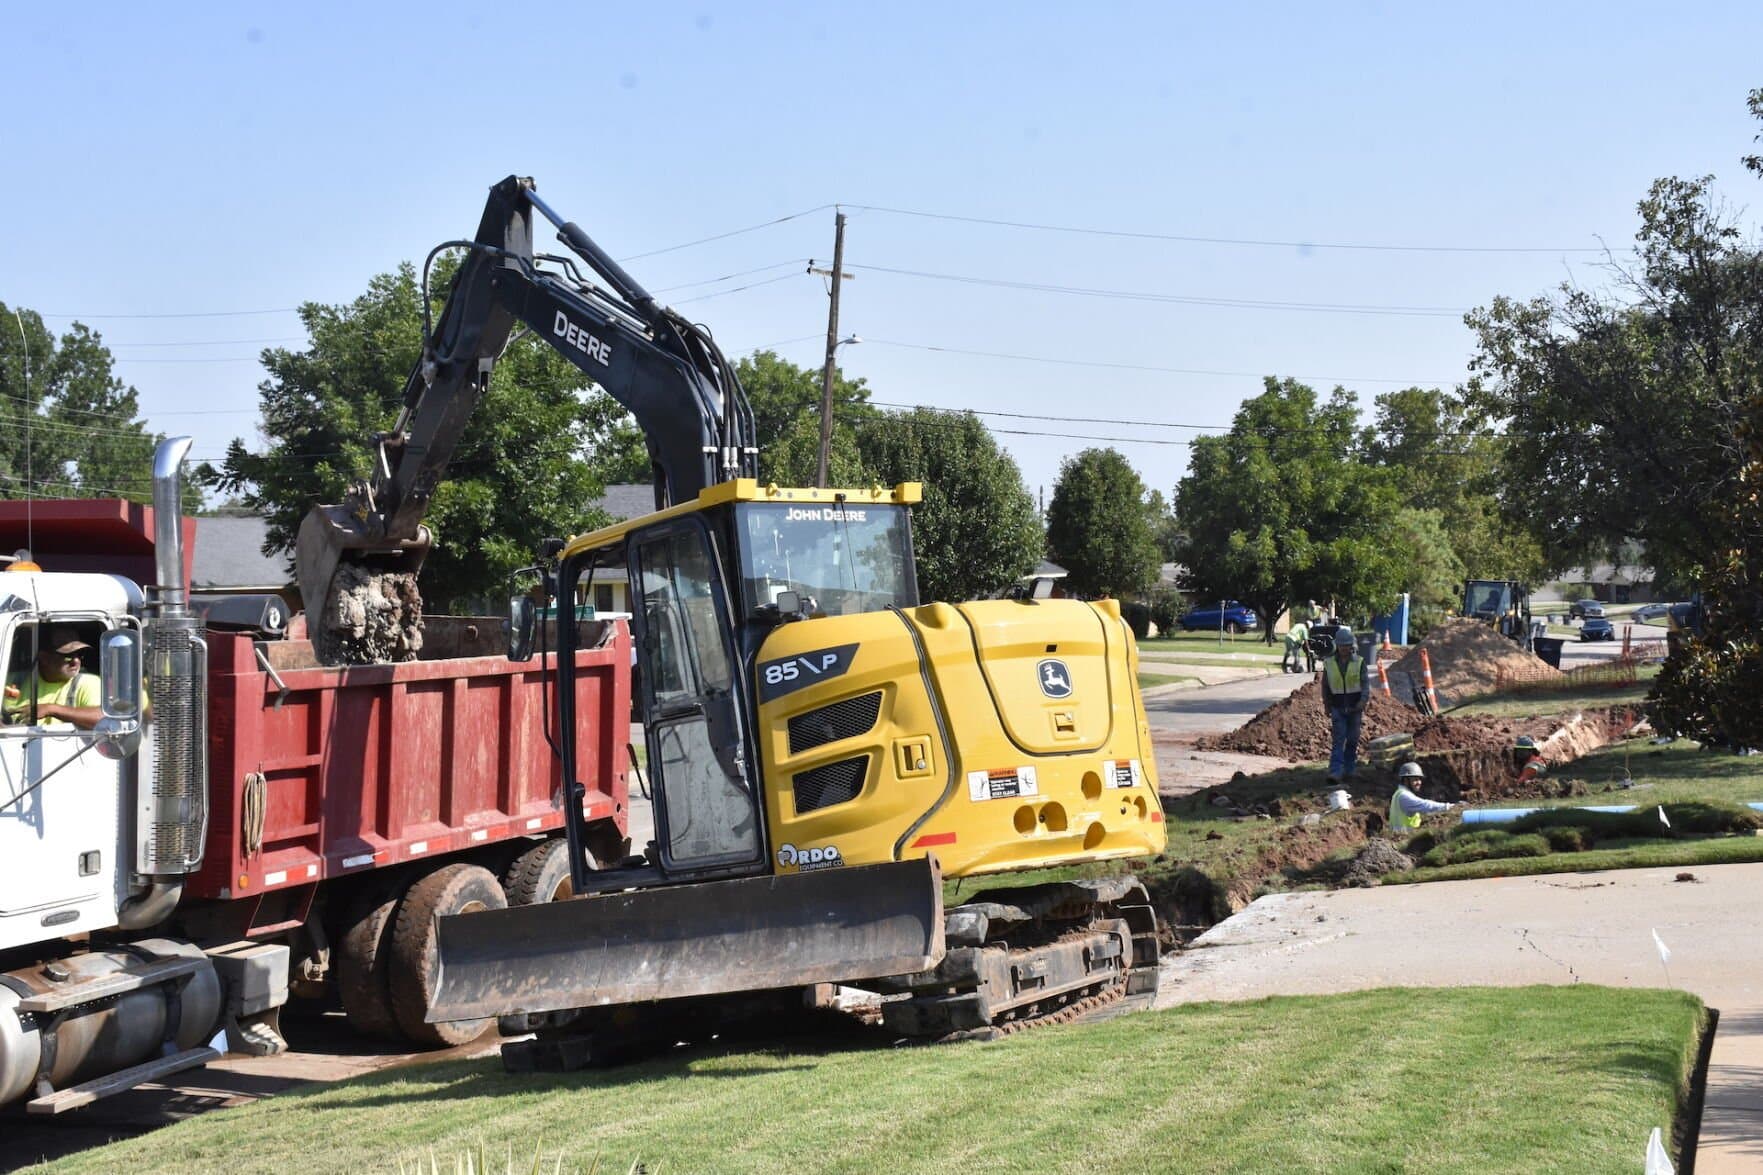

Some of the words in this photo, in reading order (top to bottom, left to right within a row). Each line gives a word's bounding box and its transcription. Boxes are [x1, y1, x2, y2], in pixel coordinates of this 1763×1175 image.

[553, 310, 611, 367] DEERE
[785, 507, 821, 521] JOHN
[823, 508, 867, 521] DEERE
